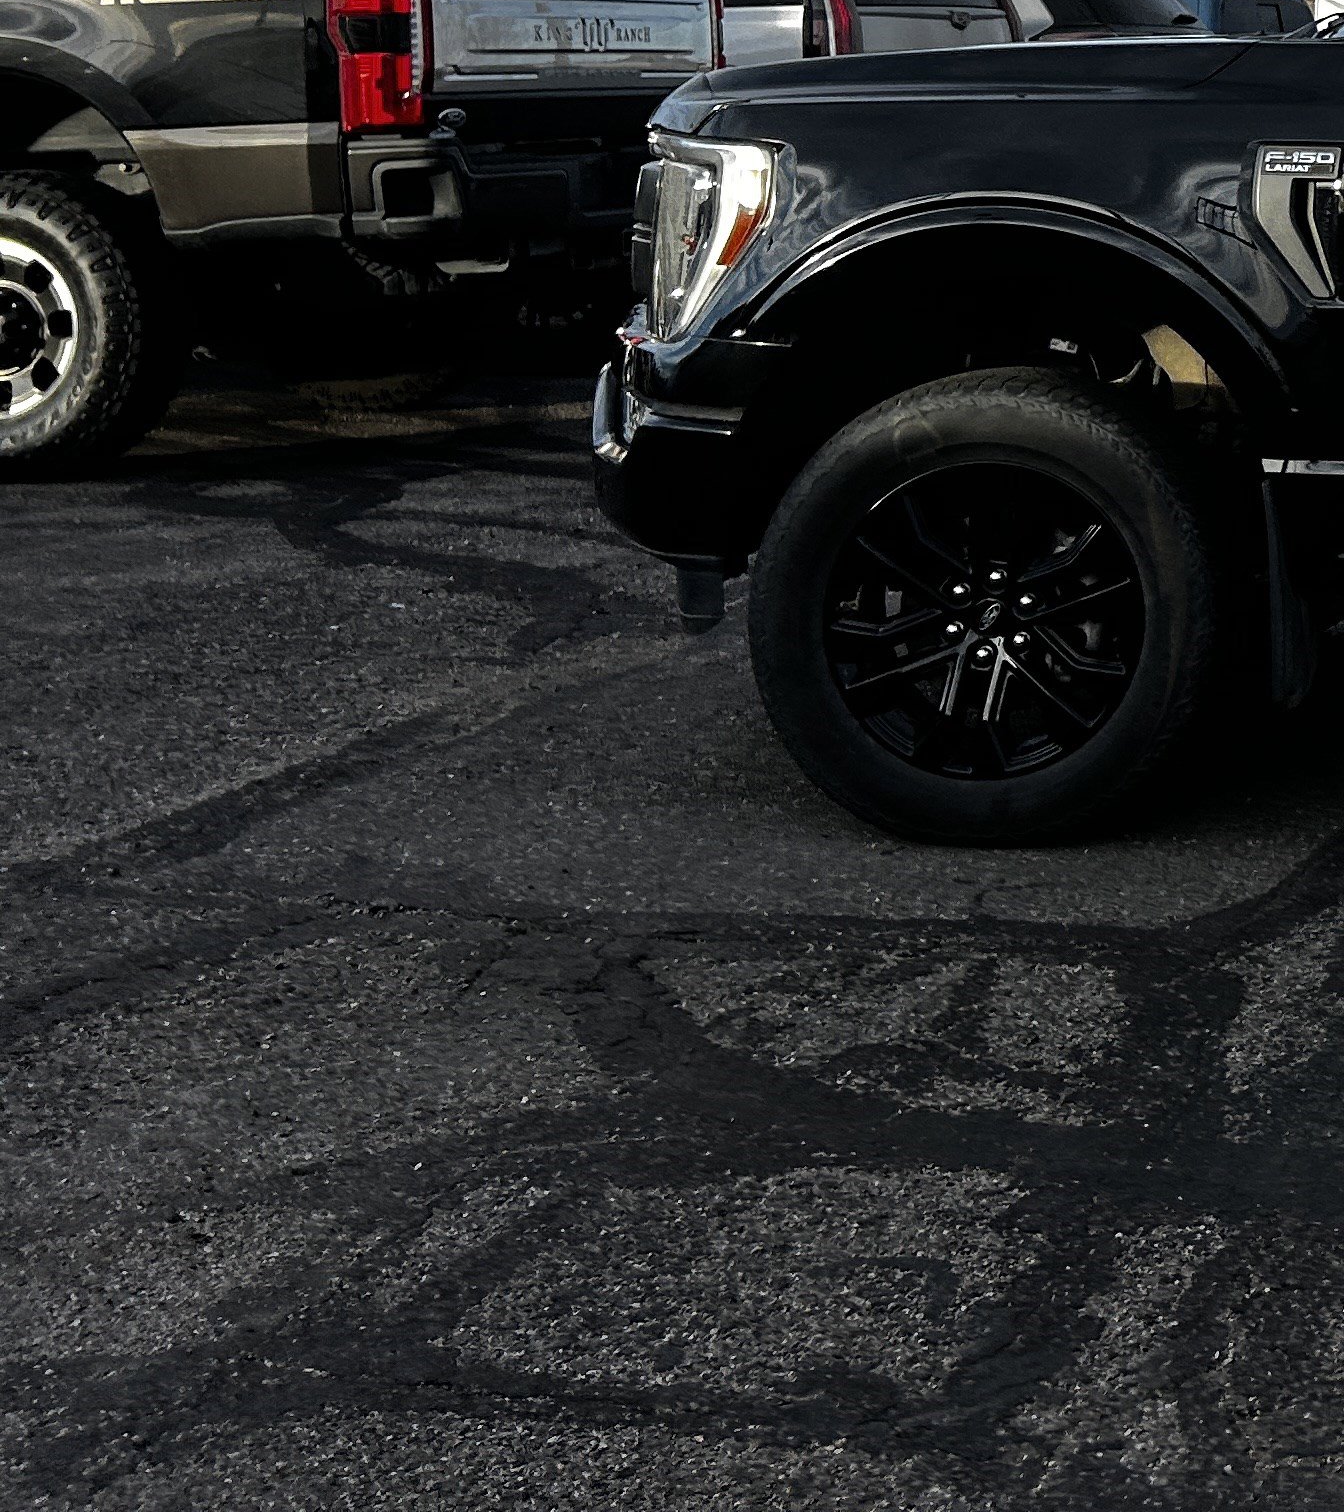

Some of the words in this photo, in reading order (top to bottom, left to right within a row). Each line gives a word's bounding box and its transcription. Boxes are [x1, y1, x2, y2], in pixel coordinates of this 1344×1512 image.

[533, 24, 573, 42] KING
[616, 25, 651, 43] RANCH
[1264, 151, 1335, 164] F-150
[1265, 163, 1312, 173] LARIAT
